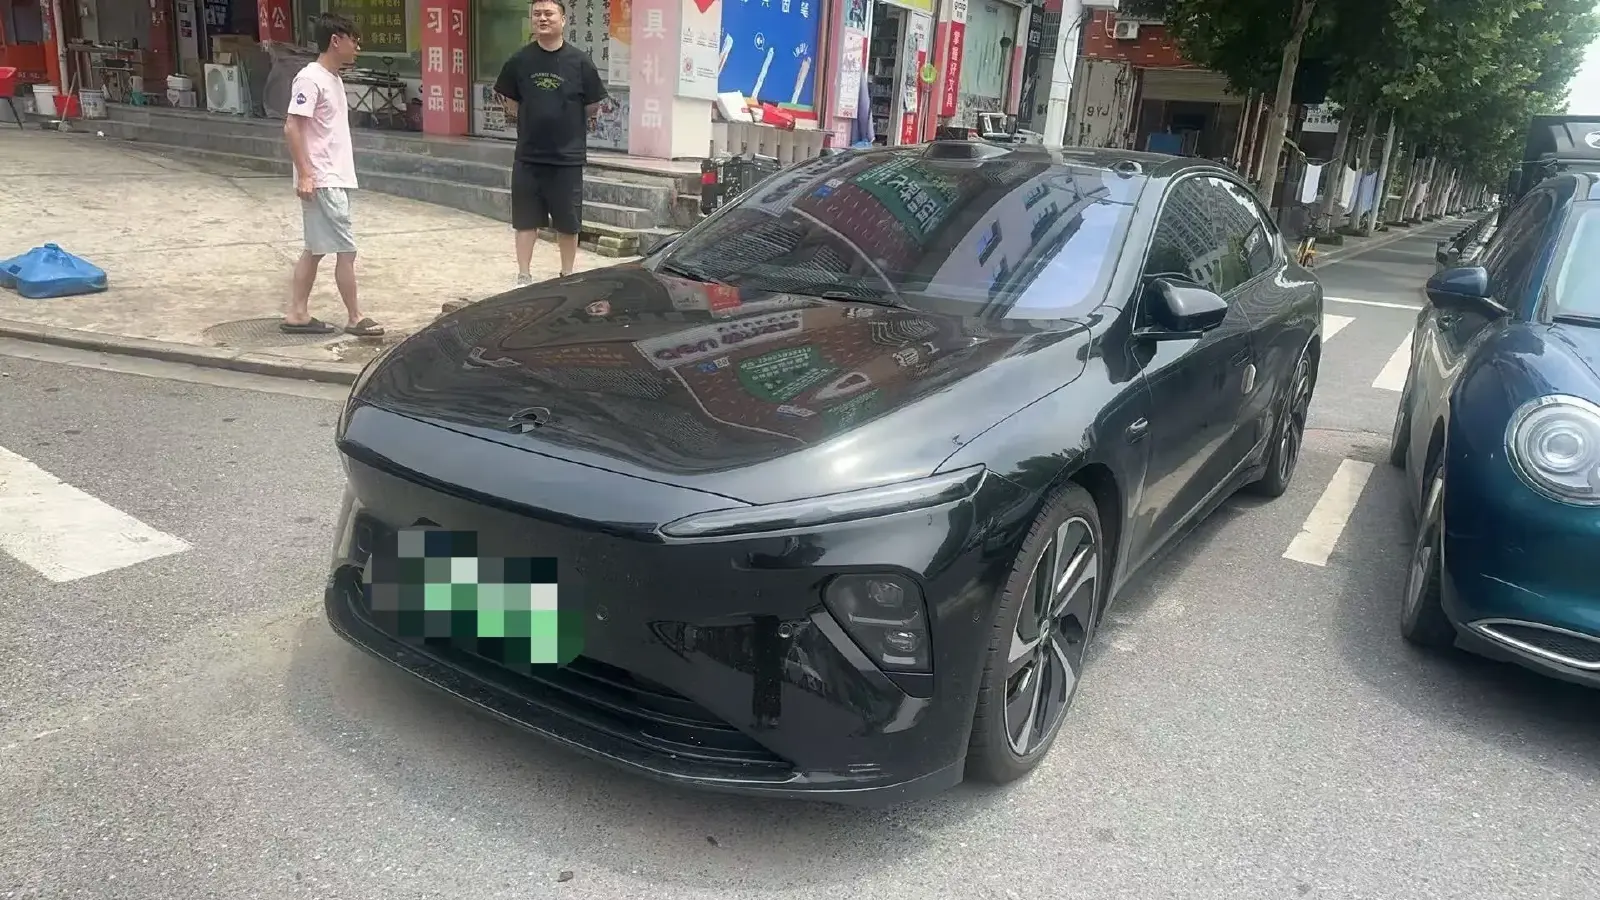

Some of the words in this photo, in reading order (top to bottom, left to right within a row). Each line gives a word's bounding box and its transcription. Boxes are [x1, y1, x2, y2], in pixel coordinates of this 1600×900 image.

[426, 7, 444, 112] 习用品
[451, 8, 466, 114] 习用品
[641, 8, 667, 128] 具礼品
